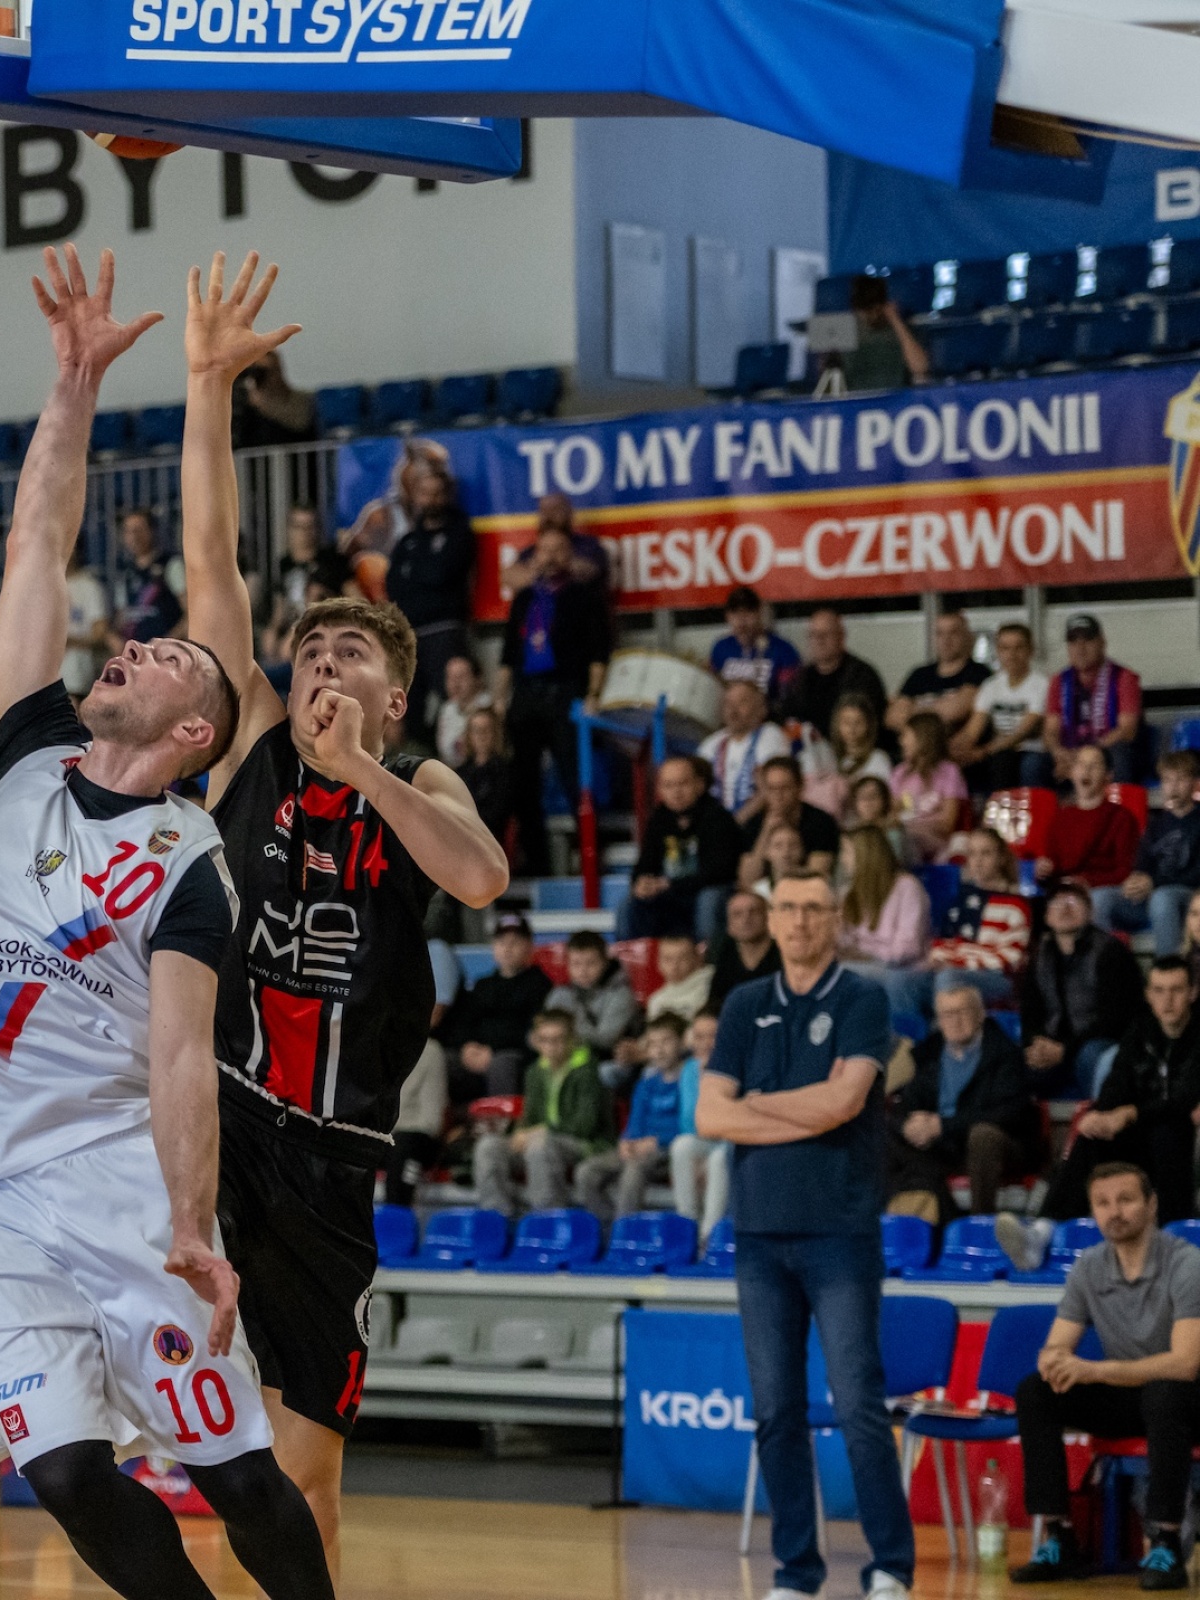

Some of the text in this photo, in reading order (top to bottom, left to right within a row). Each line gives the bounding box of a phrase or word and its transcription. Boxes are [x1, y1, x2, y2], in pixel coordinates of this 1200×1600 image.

[129, 0, 533, 44] SPORT SYSTEM
[519, 393, 1101, 496] TO MY FANI POLONII
[82, 841, 165, 920] 10
[344, 821, 388, 890] 14
[314, 983, 351, 996] ESTATE
[155, 1368, 235, 1444] 10
